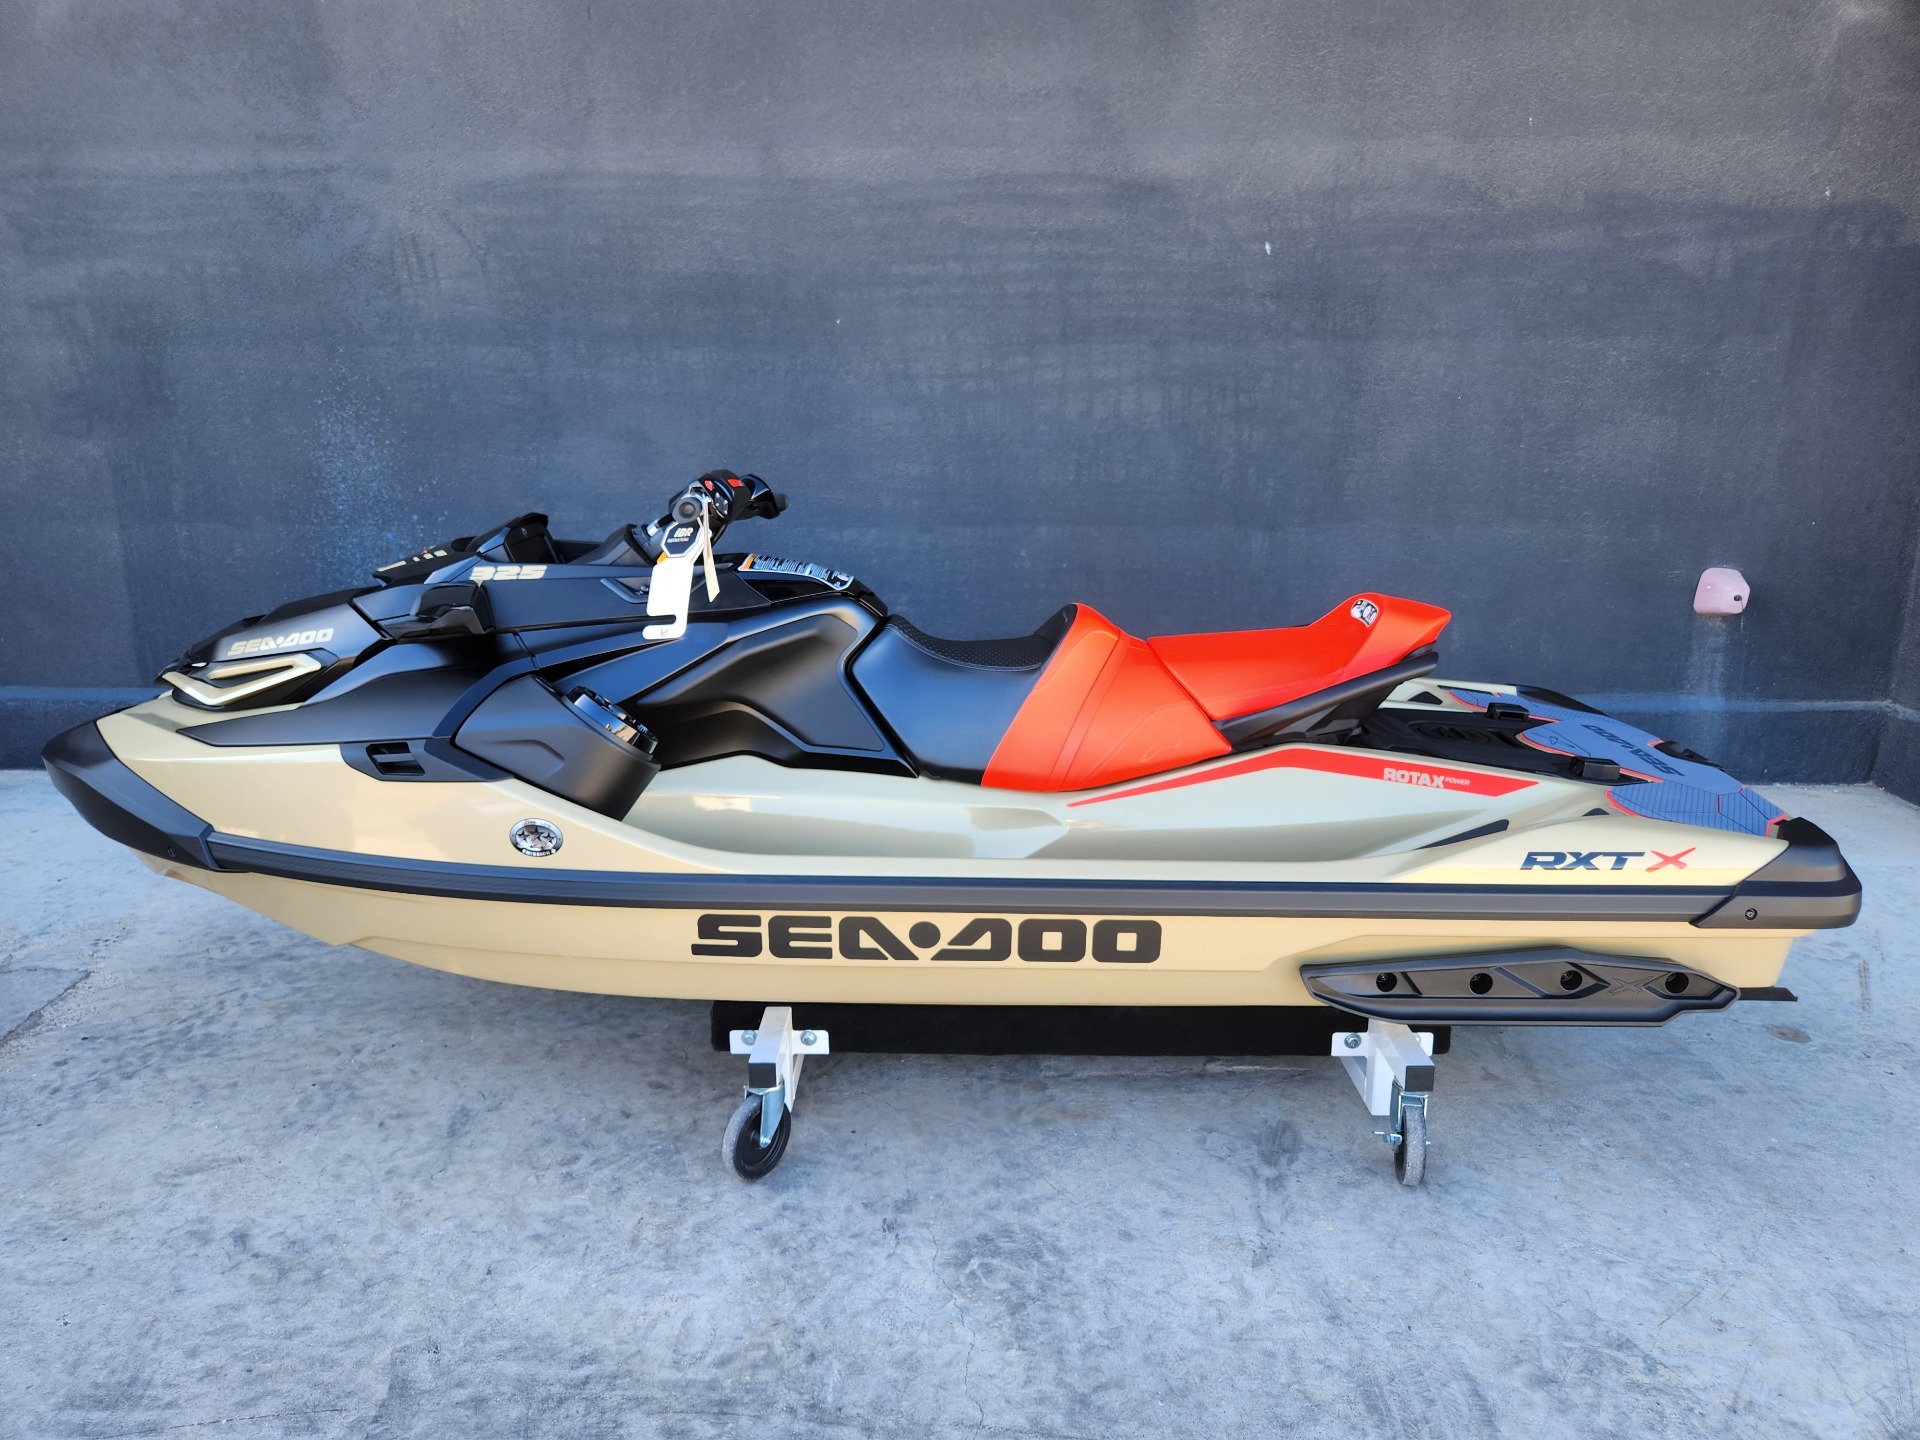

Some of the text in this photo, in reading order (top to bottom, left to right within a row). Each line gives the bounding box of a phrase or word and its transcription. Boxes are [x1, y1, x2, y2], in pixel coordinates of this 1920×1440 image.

[469, 565, 547, 580] 325
[1383, 767, 1470, 789] ROTAX POWER
[1519, 846, 1697, 873] RXT X
